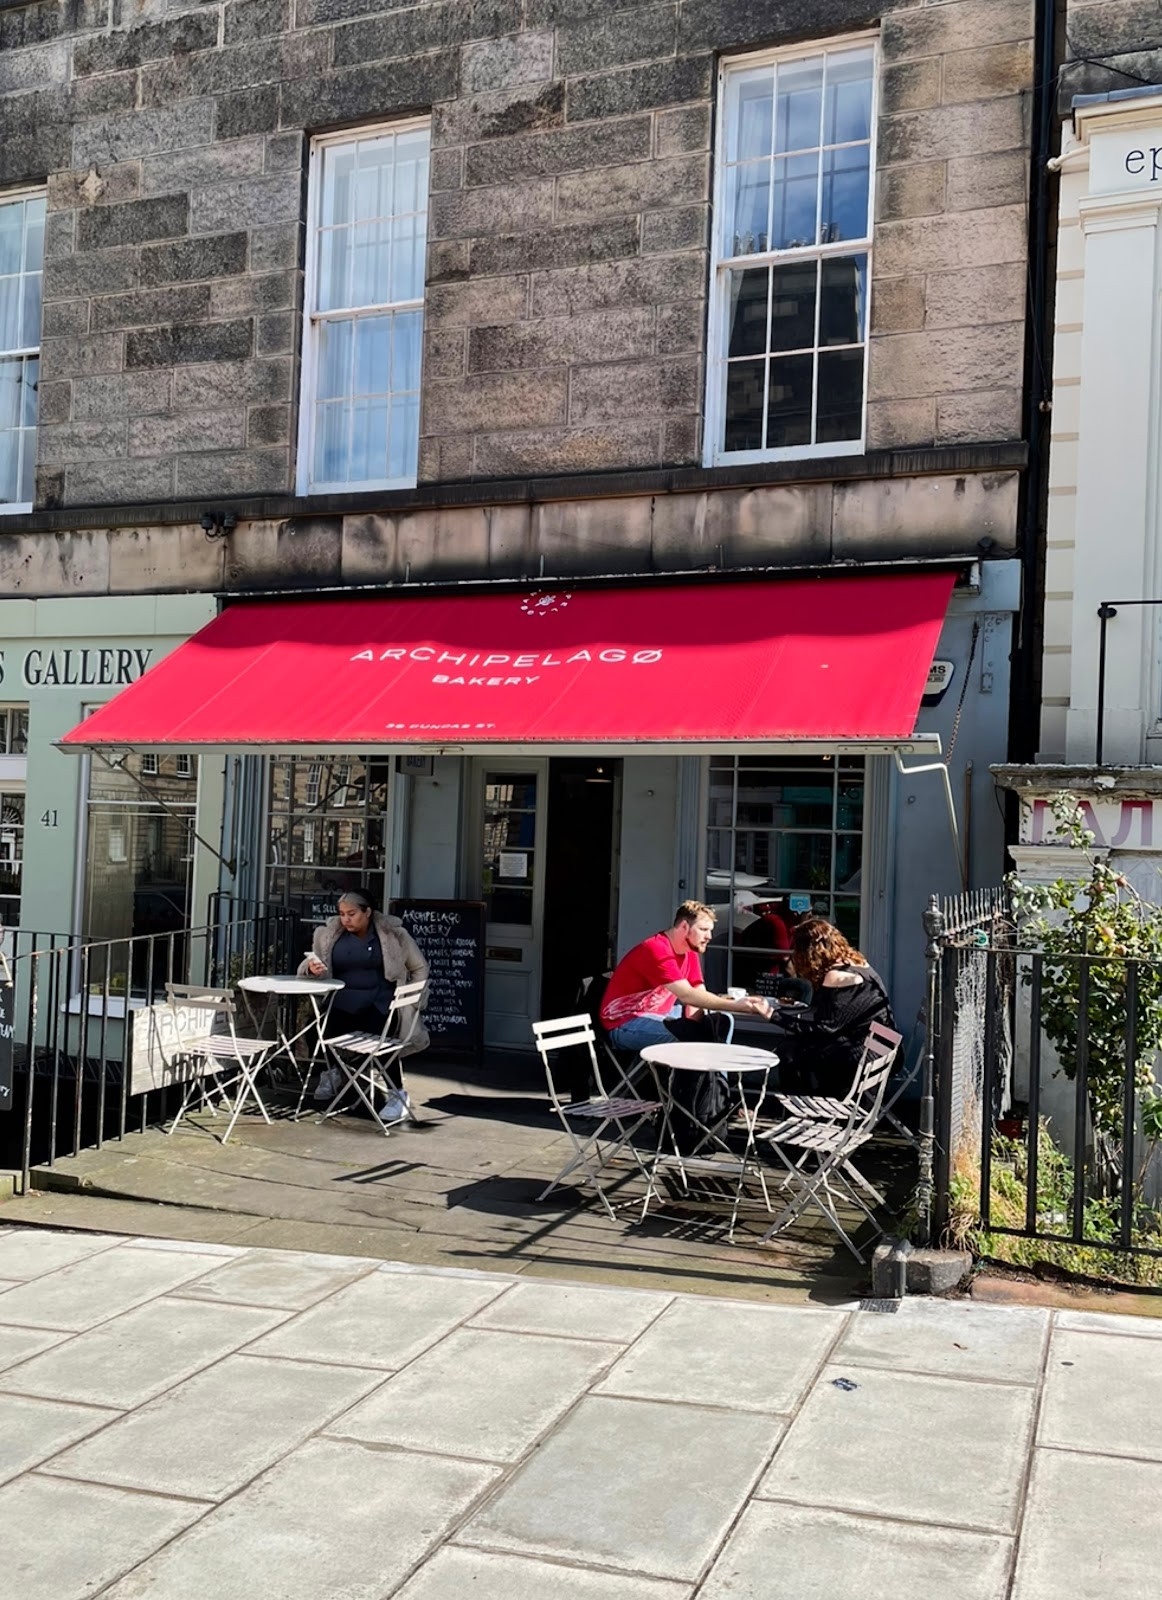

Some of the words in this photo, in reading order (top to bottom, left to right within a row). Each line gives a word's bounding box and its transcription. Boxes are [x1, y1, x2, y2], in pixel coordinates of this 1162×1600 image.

[24, 649, 153, 686] GALLERY
[432, 674, 540, 686] BAKERY
[40, 809, 59, 827] 41
[412, 923, 453, 937] BAKERY
